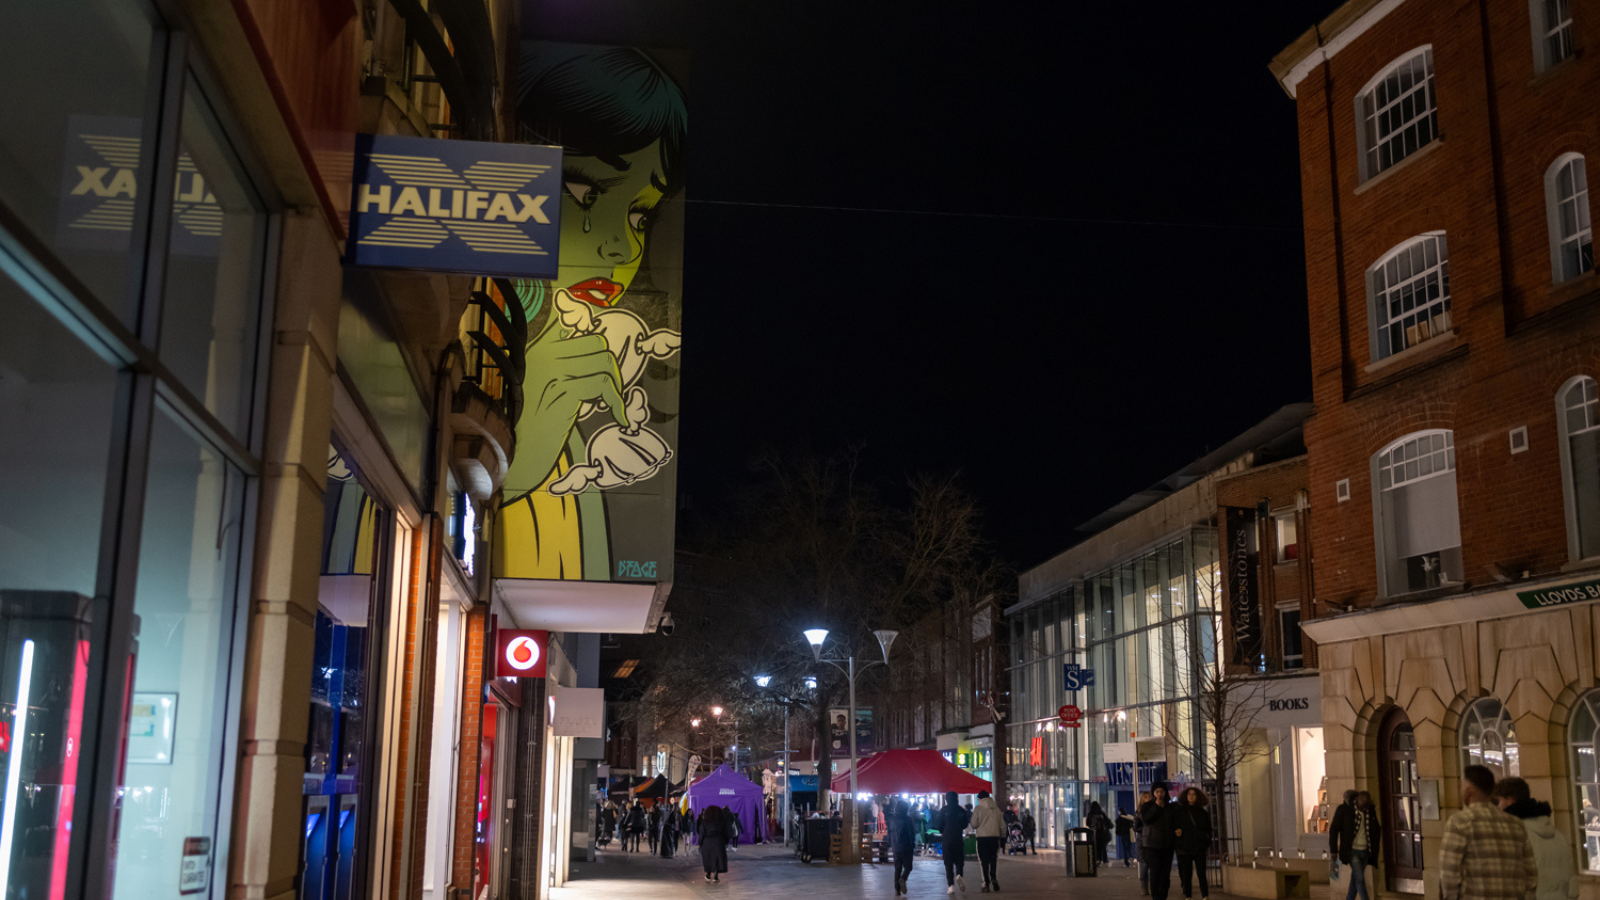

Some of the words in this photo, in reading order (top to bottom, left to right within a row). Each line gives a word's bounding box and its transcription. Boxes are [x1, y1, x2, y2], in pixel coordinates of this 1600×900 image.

[357, 183, 551, 225] HALIFAX
[1235, 529, 1251, 641] Waterstones
[1534, 587, 1587, 606] LLOYDS
[1067, 670, 1080, 689] S
[1269, 697, 1309, 711] BOOKS
